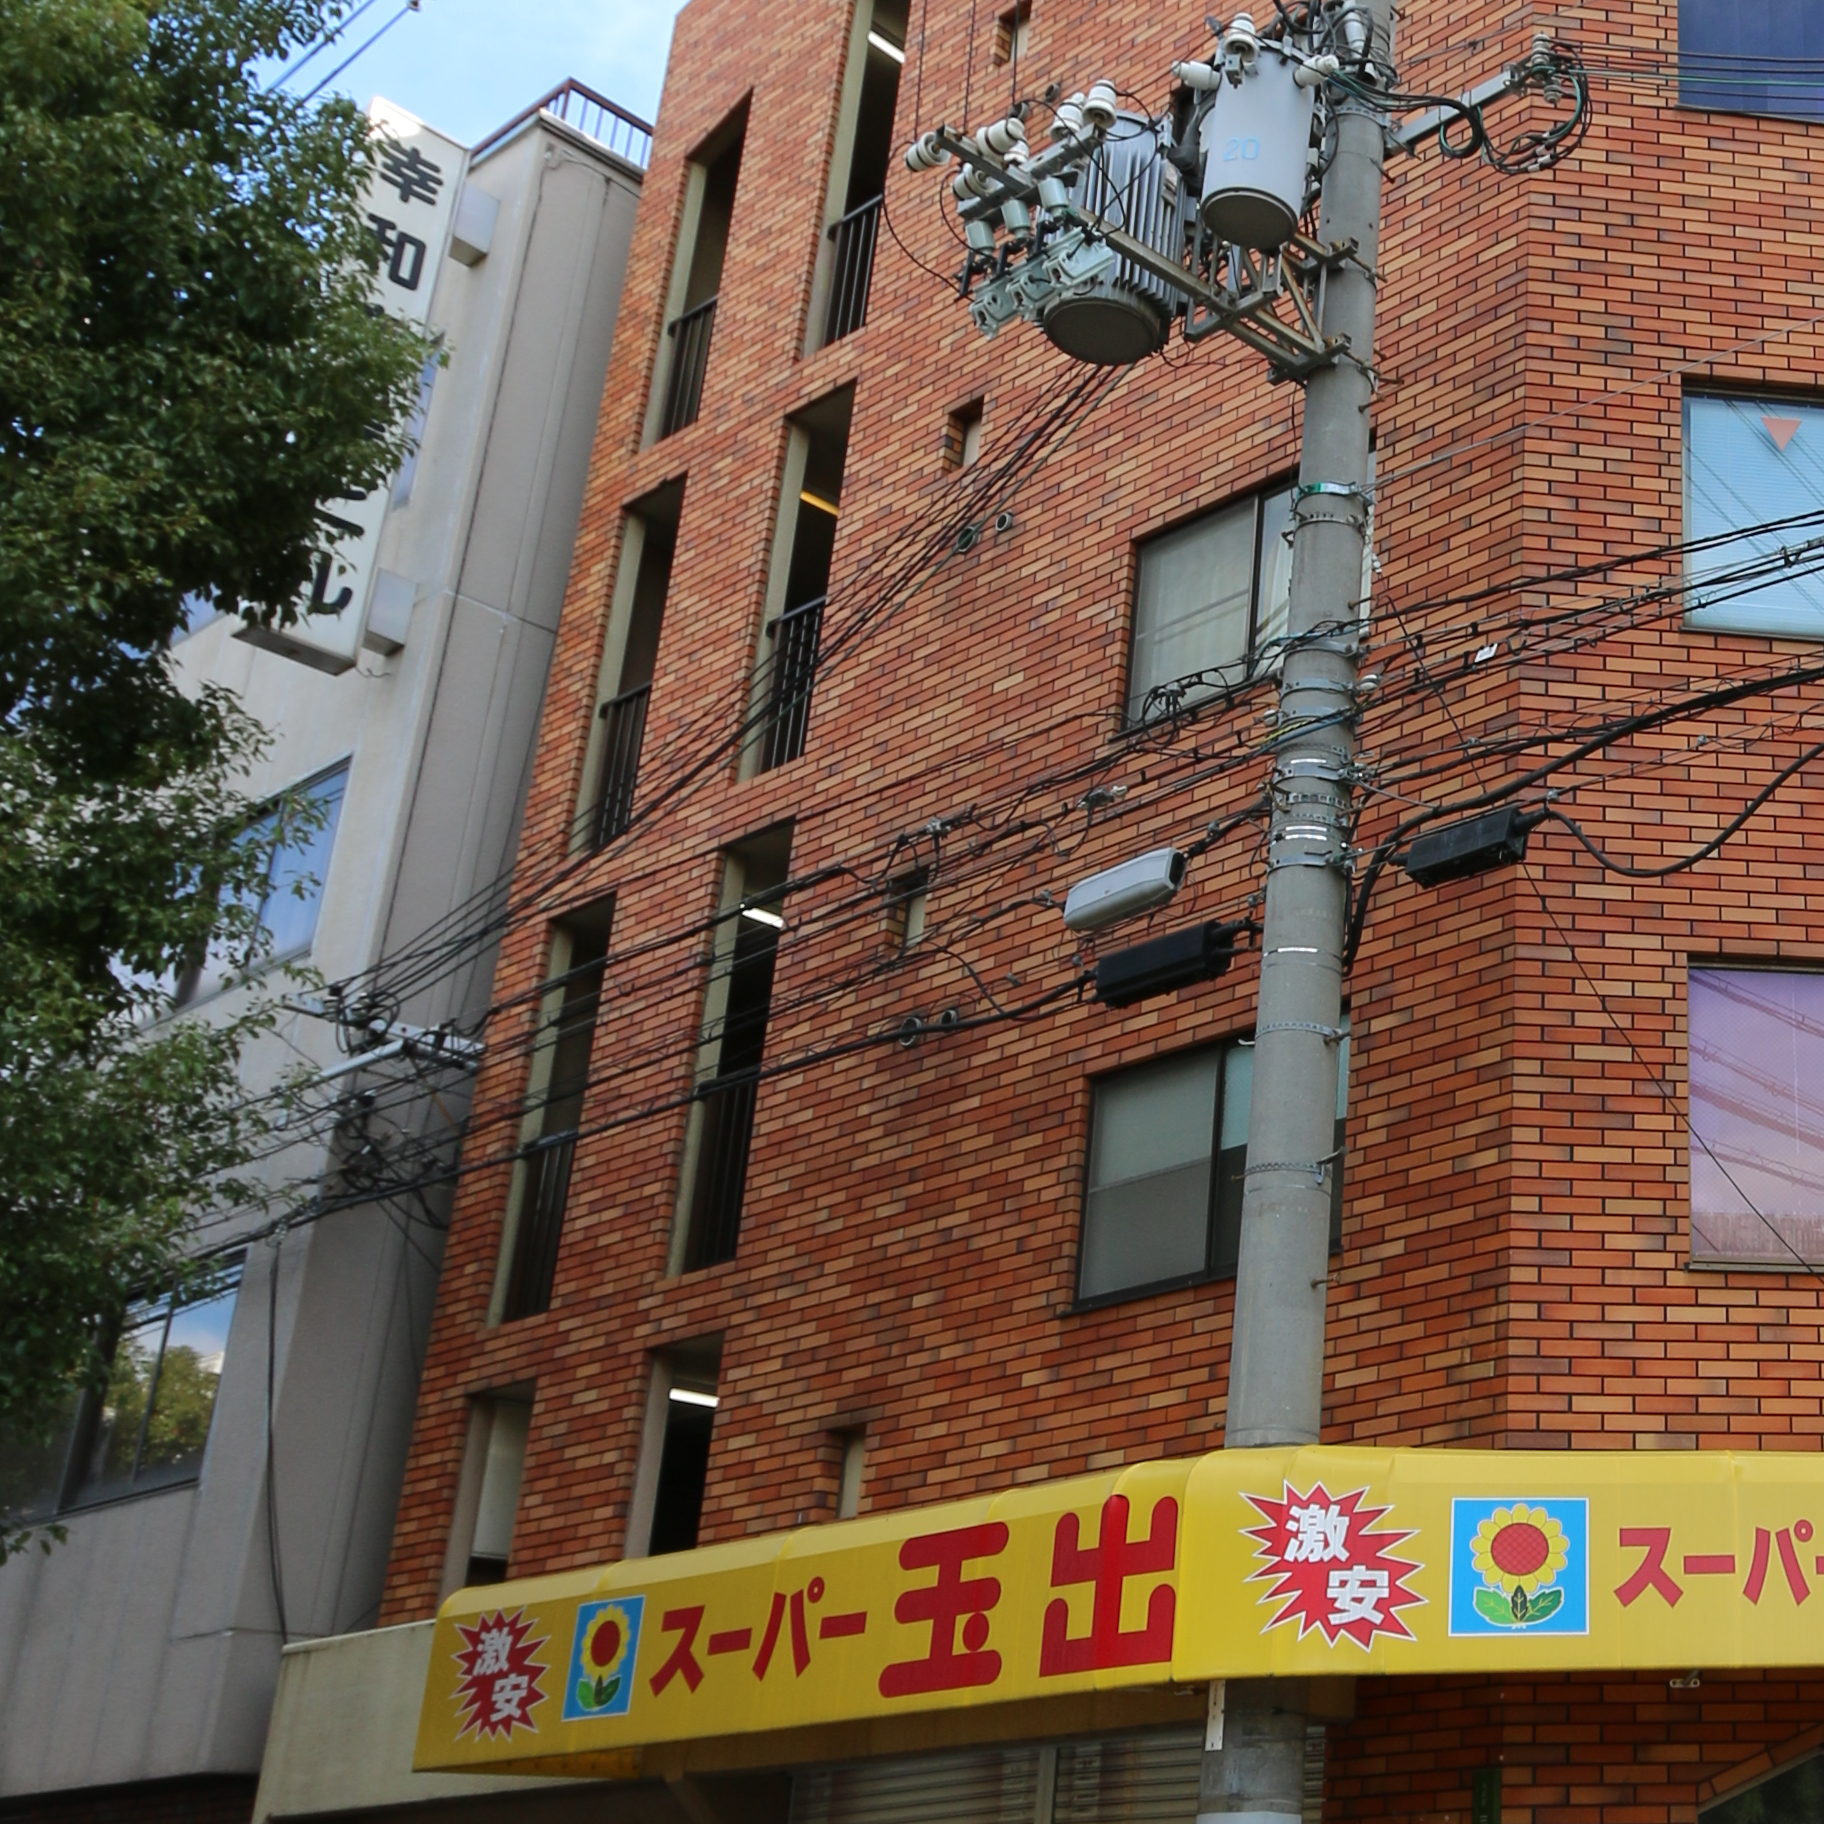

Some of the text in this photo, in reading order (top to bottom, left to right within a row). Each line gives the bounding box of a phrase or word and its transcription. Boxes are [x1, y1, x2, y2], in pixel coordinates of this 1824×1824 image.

[1221, 136, 1260, 162] 20
[648, 1493, 1178, 1699] スーパー玉出
[1284, 1503, 1391, 1626] 激安
[474, 1627, 524, 1724] 激安
